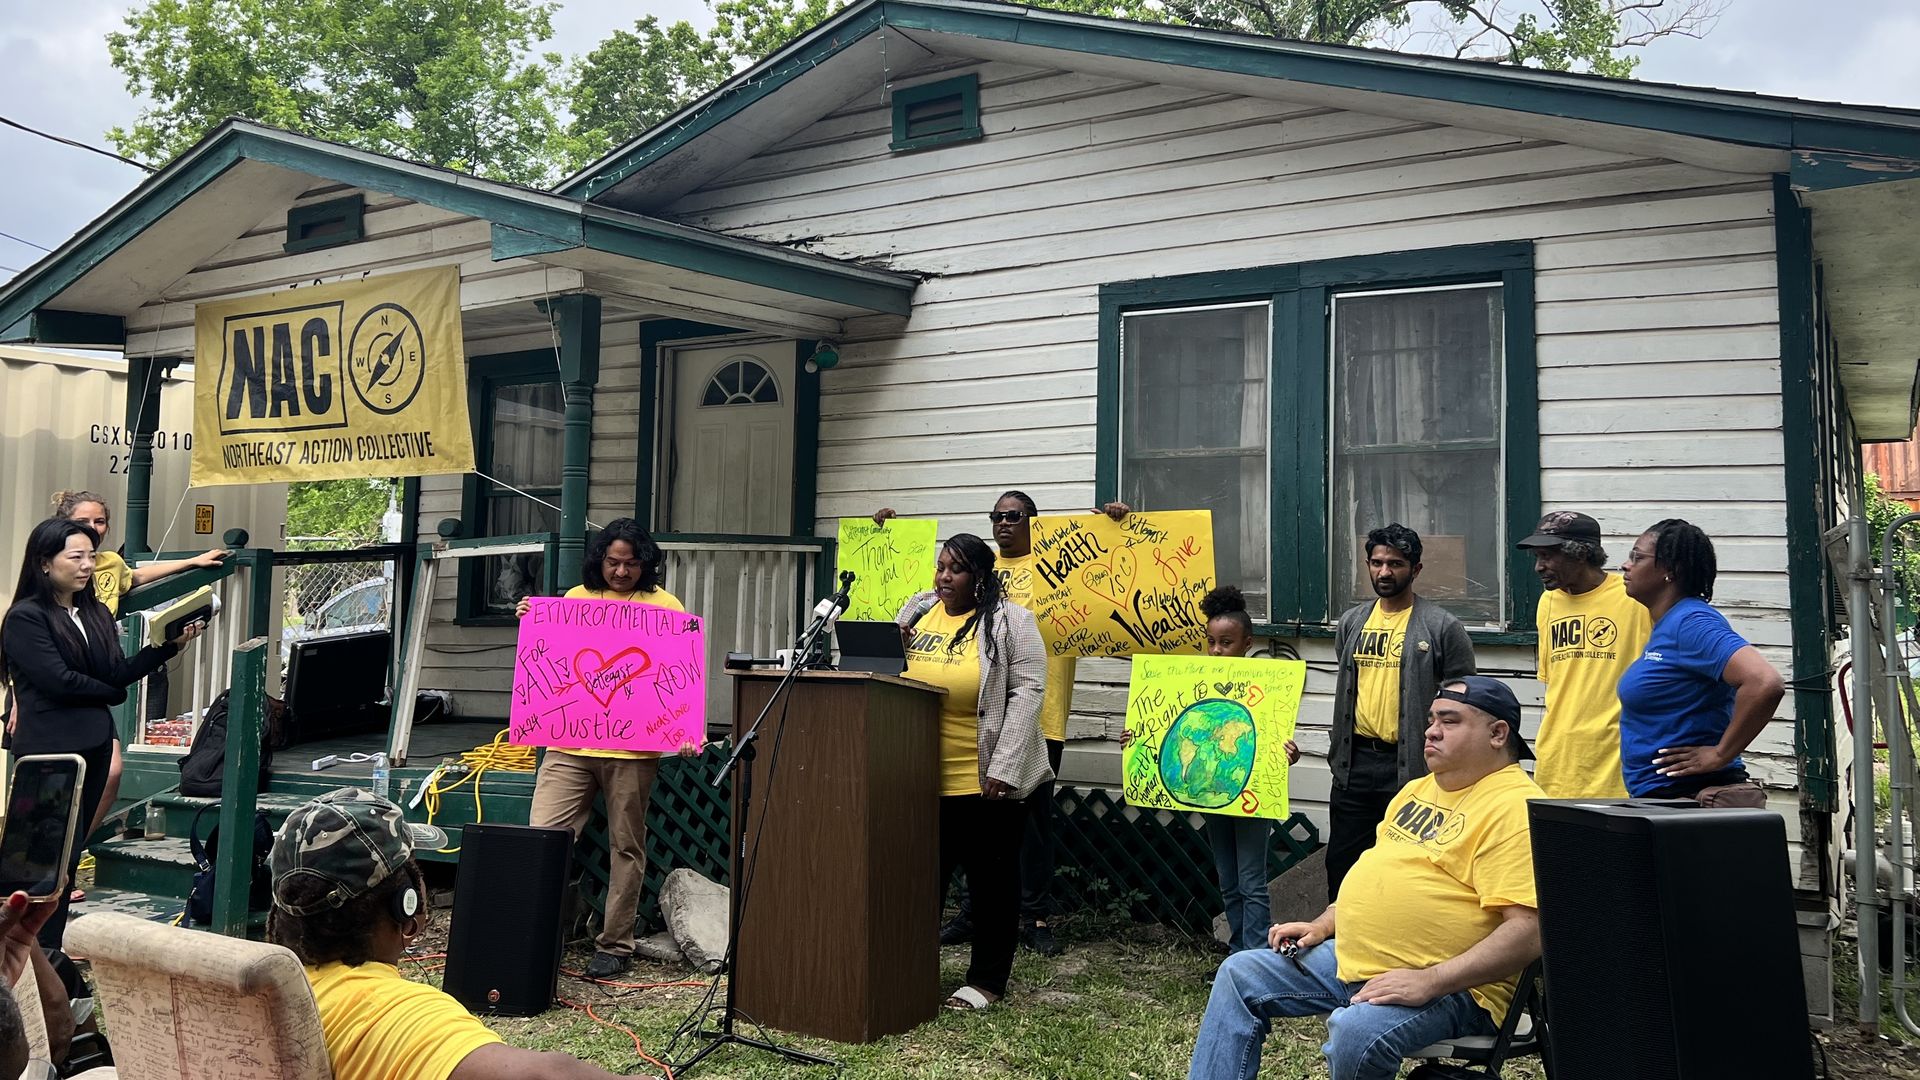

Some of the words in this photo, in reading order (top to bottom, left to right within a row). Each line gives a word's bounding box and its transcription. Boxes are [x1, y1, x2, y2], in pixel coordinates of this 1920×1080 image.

[381, 315, 388, 326] N
[226, 317, 333, 419] NAC
[356, 357, 365, 368] W
[409, 351, 416, 362] E
[385, 393, 392, 404] S
[222, 441, 297, 470] NORTHEAST
[299, 438, 353, 465] ACTION
[358, 431, 435, 461] COLLECTIVE
[852, 533, 900, 571] Thank
[1036, 531, 1108, 589] Health
[1153, 536, 1202, 586] Live
[1050, 600, 1092, 637] Life
[1110, 589, 1207, 648] Wealth
[1551, 619, 1581, 650] NAC
[518, 639, 549, 668] FOR
[653, 640, 701, 709] NOW
[542, 700, 635, 740] Justice
[1131, 685, 1165, 719] The
[1146, 690, 1188, 736] Right
